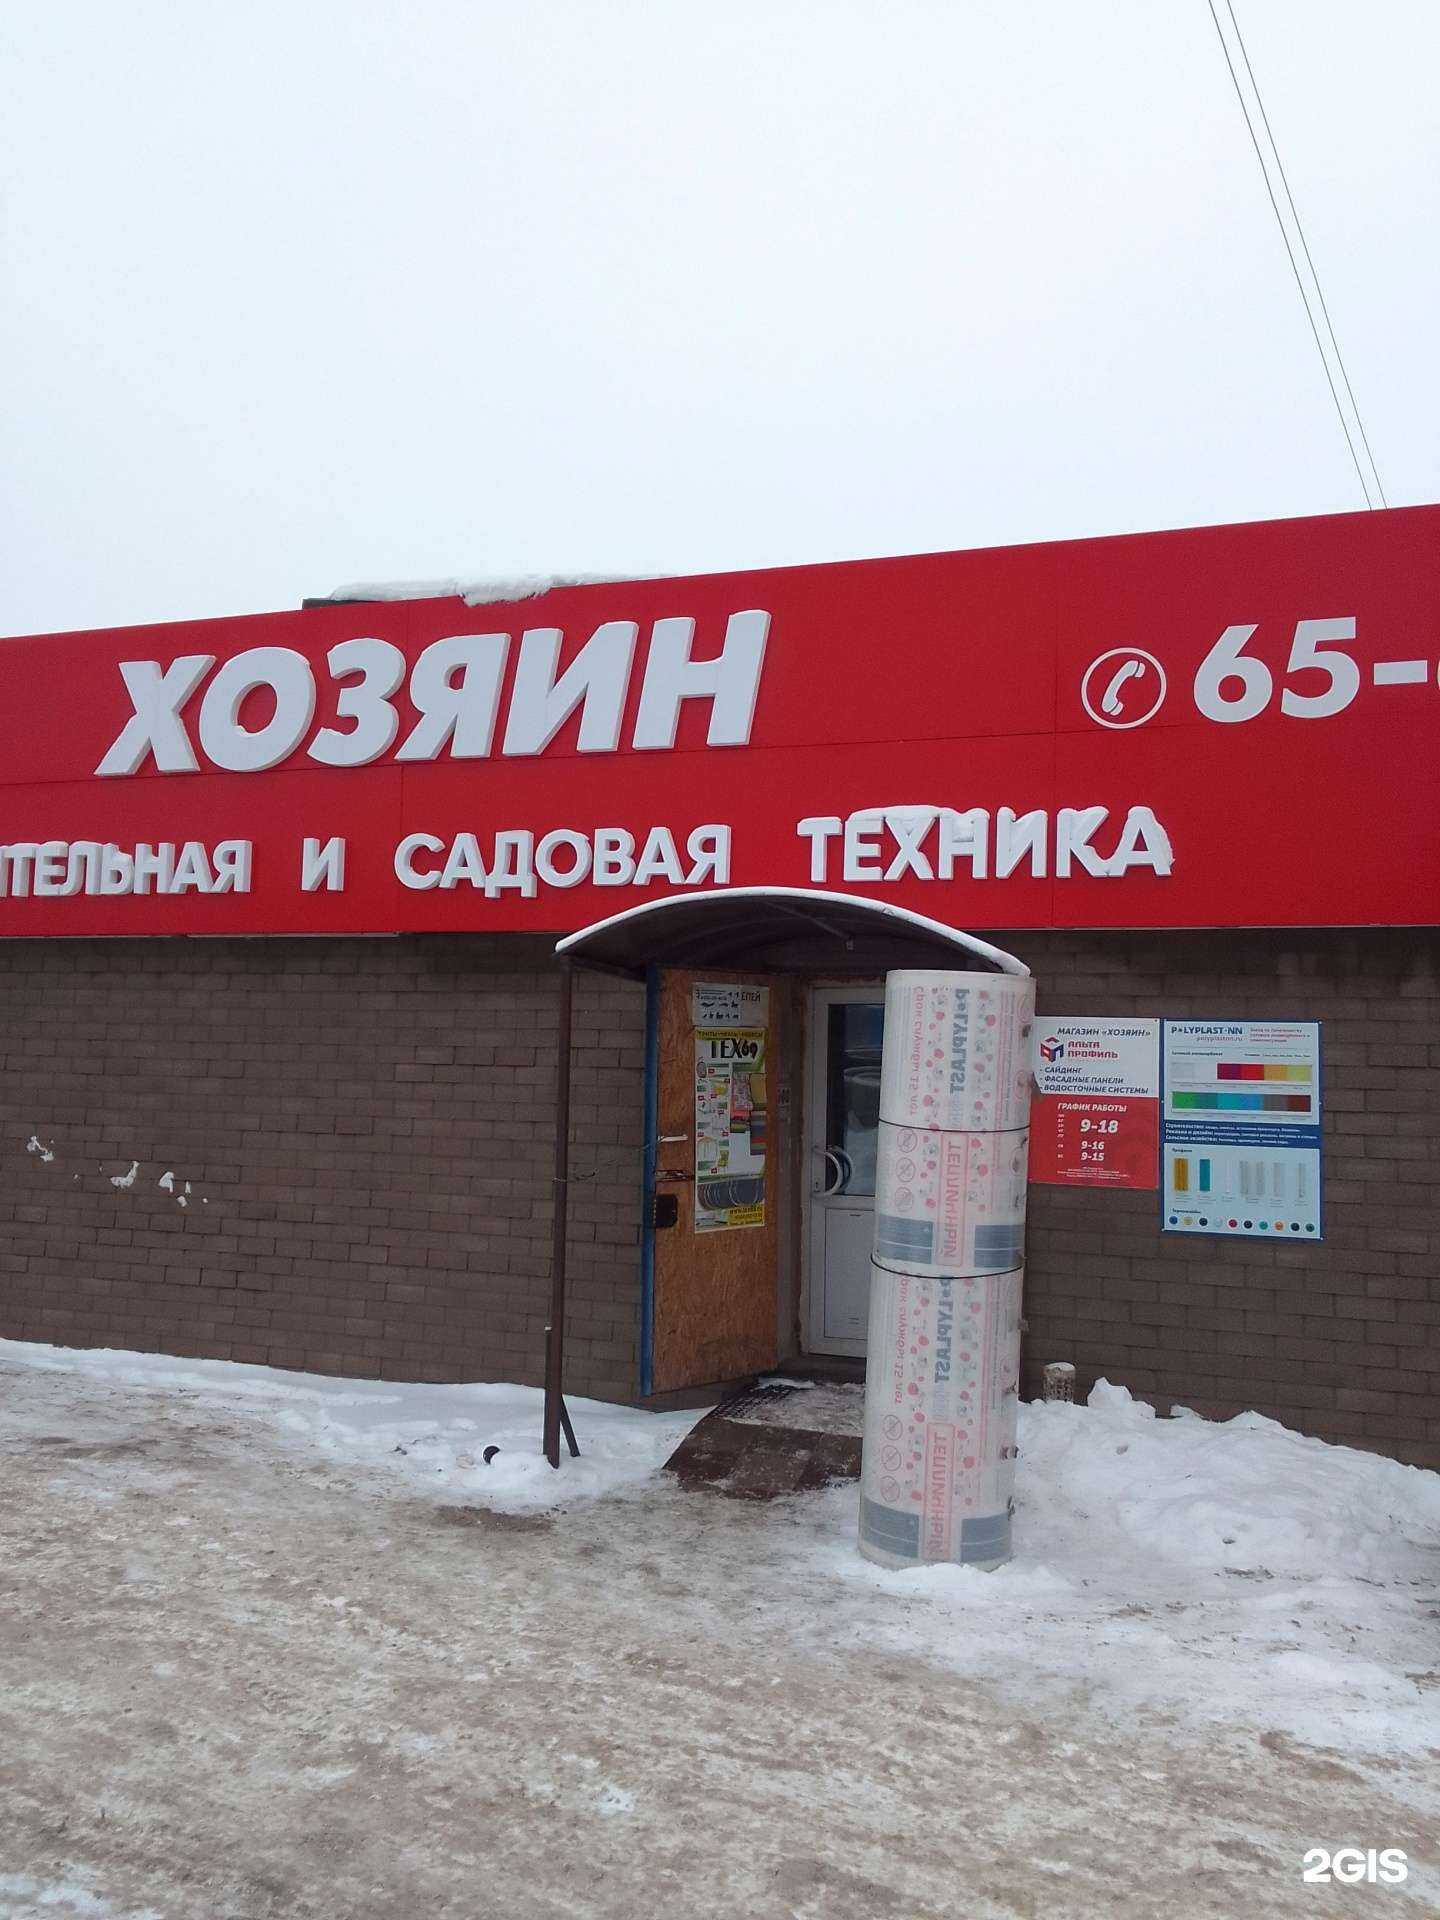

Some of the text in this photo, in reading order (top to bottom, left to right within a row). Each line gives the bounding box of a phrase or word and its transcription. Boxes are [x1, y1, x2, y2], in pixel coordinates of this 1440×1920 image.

[1193, 616, 1440, 723] 65-
[94, 610, 772, 775] ХОЗЯИН
[0, 805, 1176, 898] ТЕЛЬНАЯ И САДОВАЯ ТЕХНИКА
[1057, 1027, 1100, 1036] МАГАЗИН
[1067, 1040, 1100, 1048] АЛЬТА
[1067, 1050, 1119, 1059] ПРОФИЛЬ
[1044, 1066, 1083, 1074] САЙДИНГ
[1044, 1076, 1089, 1084] ФАСАДНЫЕ
[1044, 1085, 1149, 1094] ВОДОСТОЧНЫЕ СИСТЕМЫ
[1057, 1103, 1127, 1112] ГРАФИК РАБОТЫ
[1080, 1118, 1119, 1134] 9-18
[1081, 1141, 1105, 1150] 9-16
[1081, 1152, 1105, 1161] 9-15
